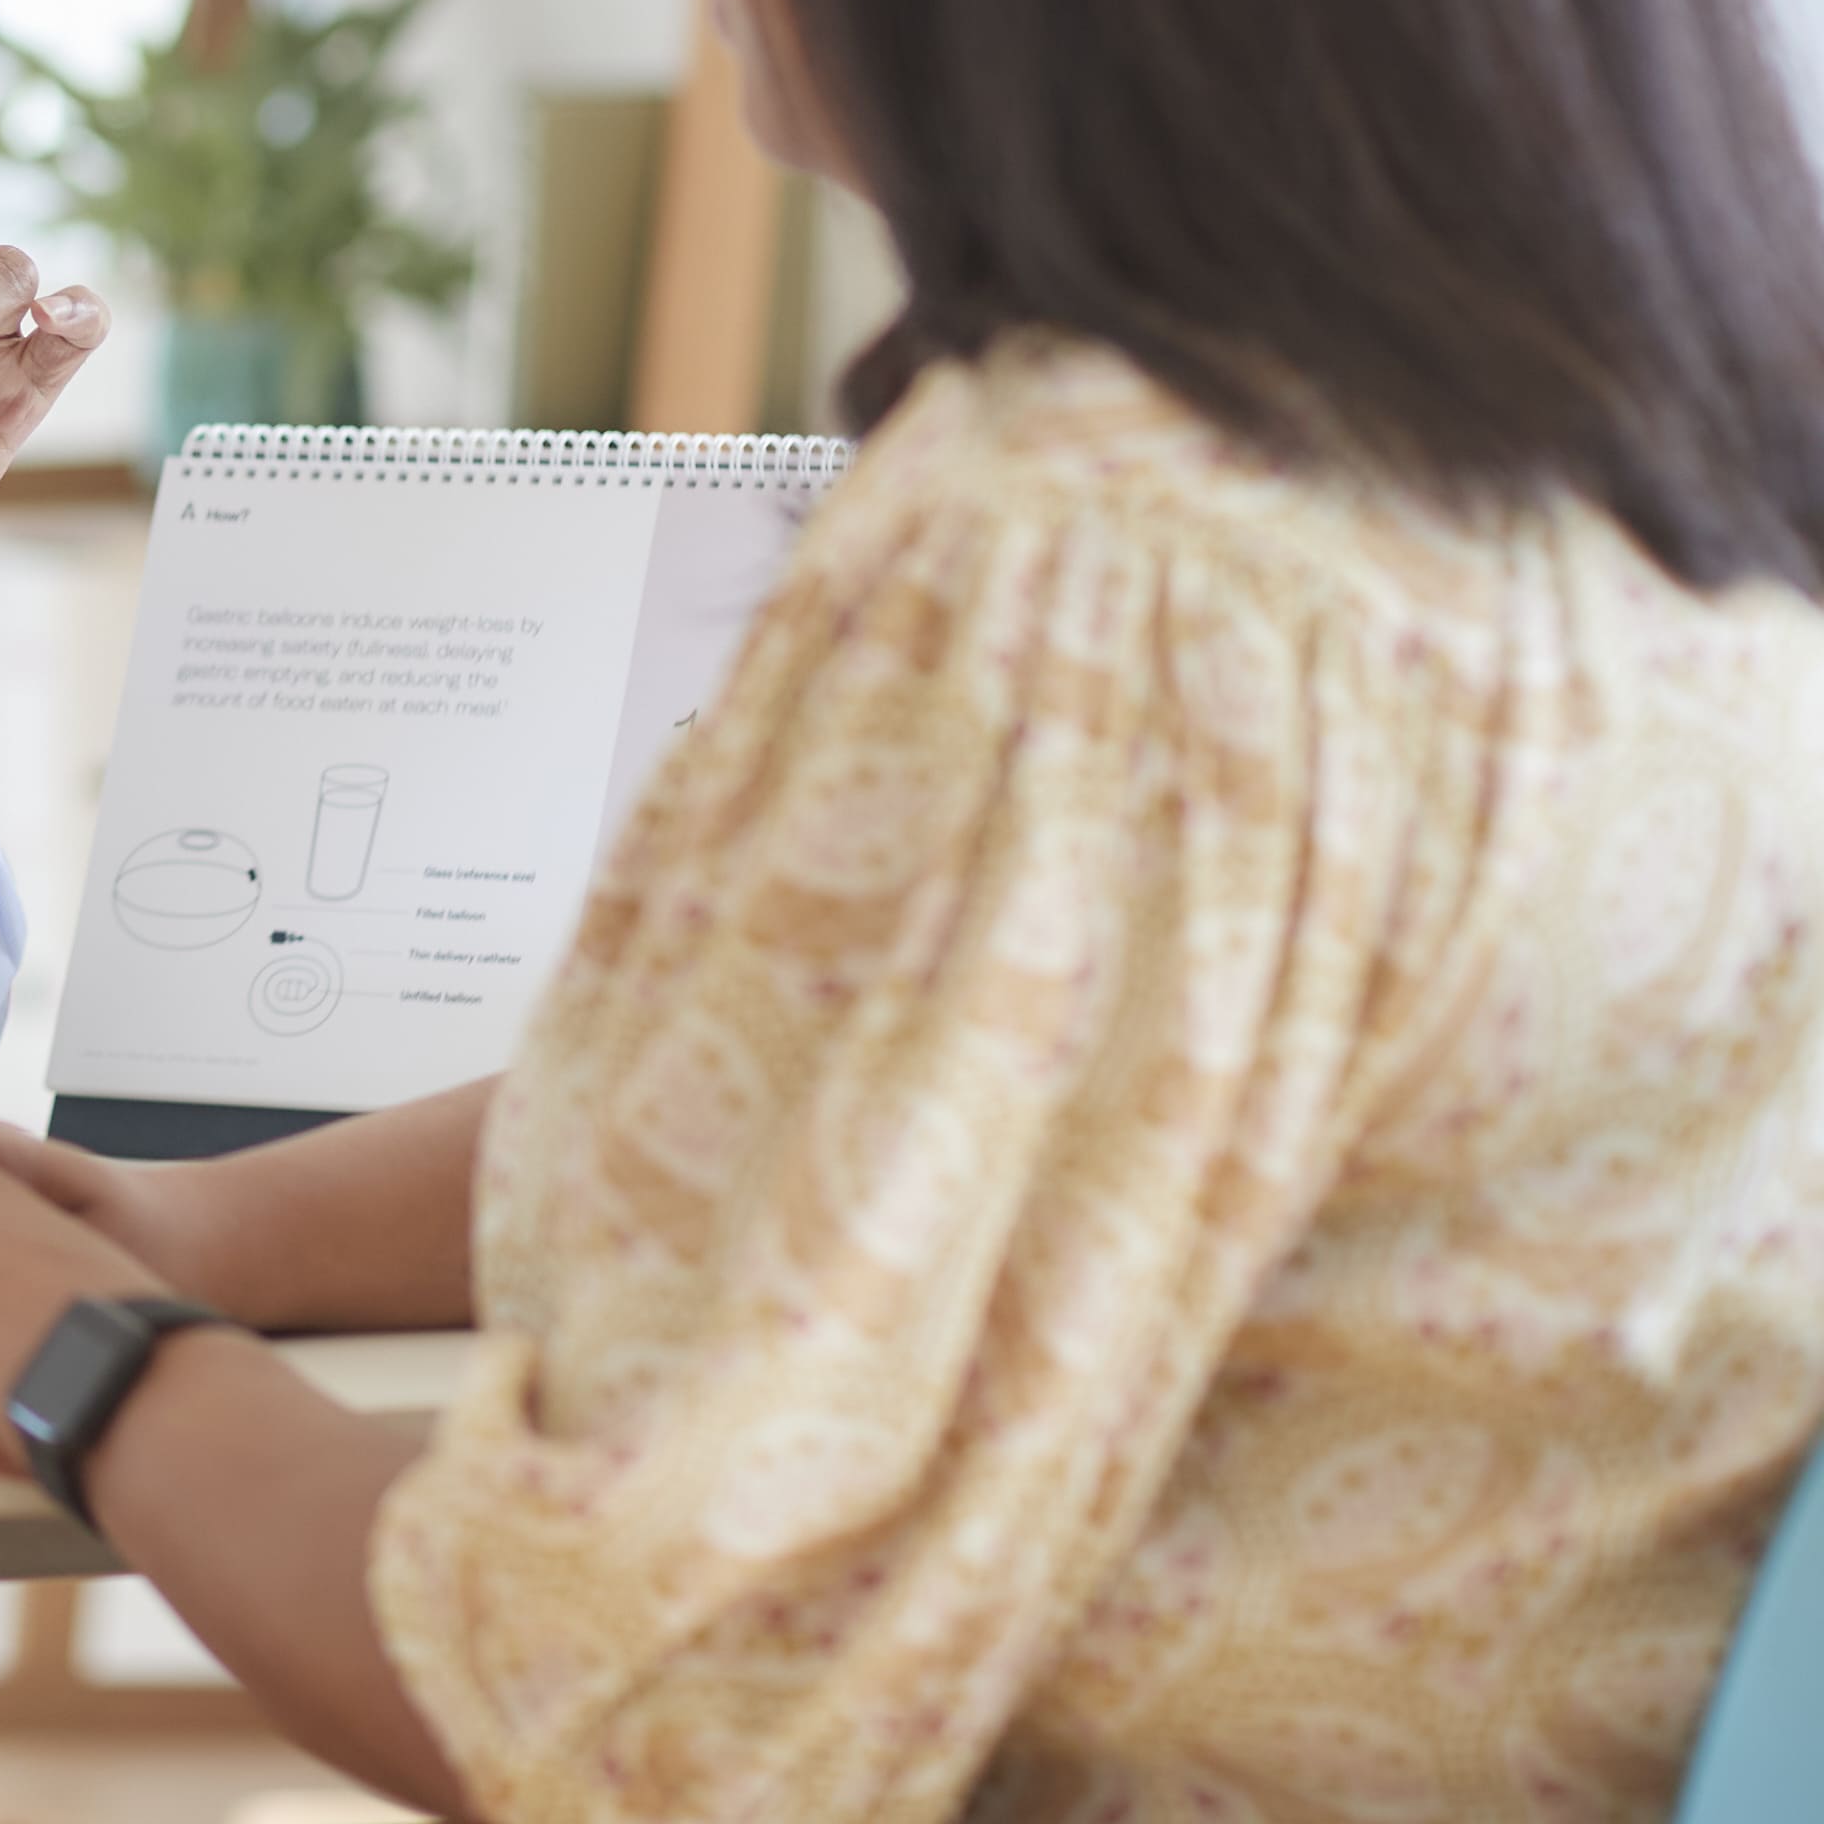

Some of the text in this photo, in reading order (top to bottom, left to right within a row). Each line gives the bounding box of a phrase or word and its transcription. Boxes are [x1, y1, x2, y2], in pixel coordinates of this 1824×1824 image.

[187, 605, 544, 637] Gastric balloons induce weight-loss by
[182, 635, 275, 659] increasing
[280, 638, 343, 660] satiety
[436, 643, 515, 666] delaying
[176, 663, 239, 685] gastric
[338, 666, 374, 687] and
[380, 669, 462, 693] reducing
[467, 670, 500, 690] the
[171, 691, 243, 710] amount
[247, 689, 269, 709] of
[272, 690, 316, 712] food
[319, 695, 372, 714] eaten
[378, 695, 398, 714] at
[402, 695, 450, 716] each
